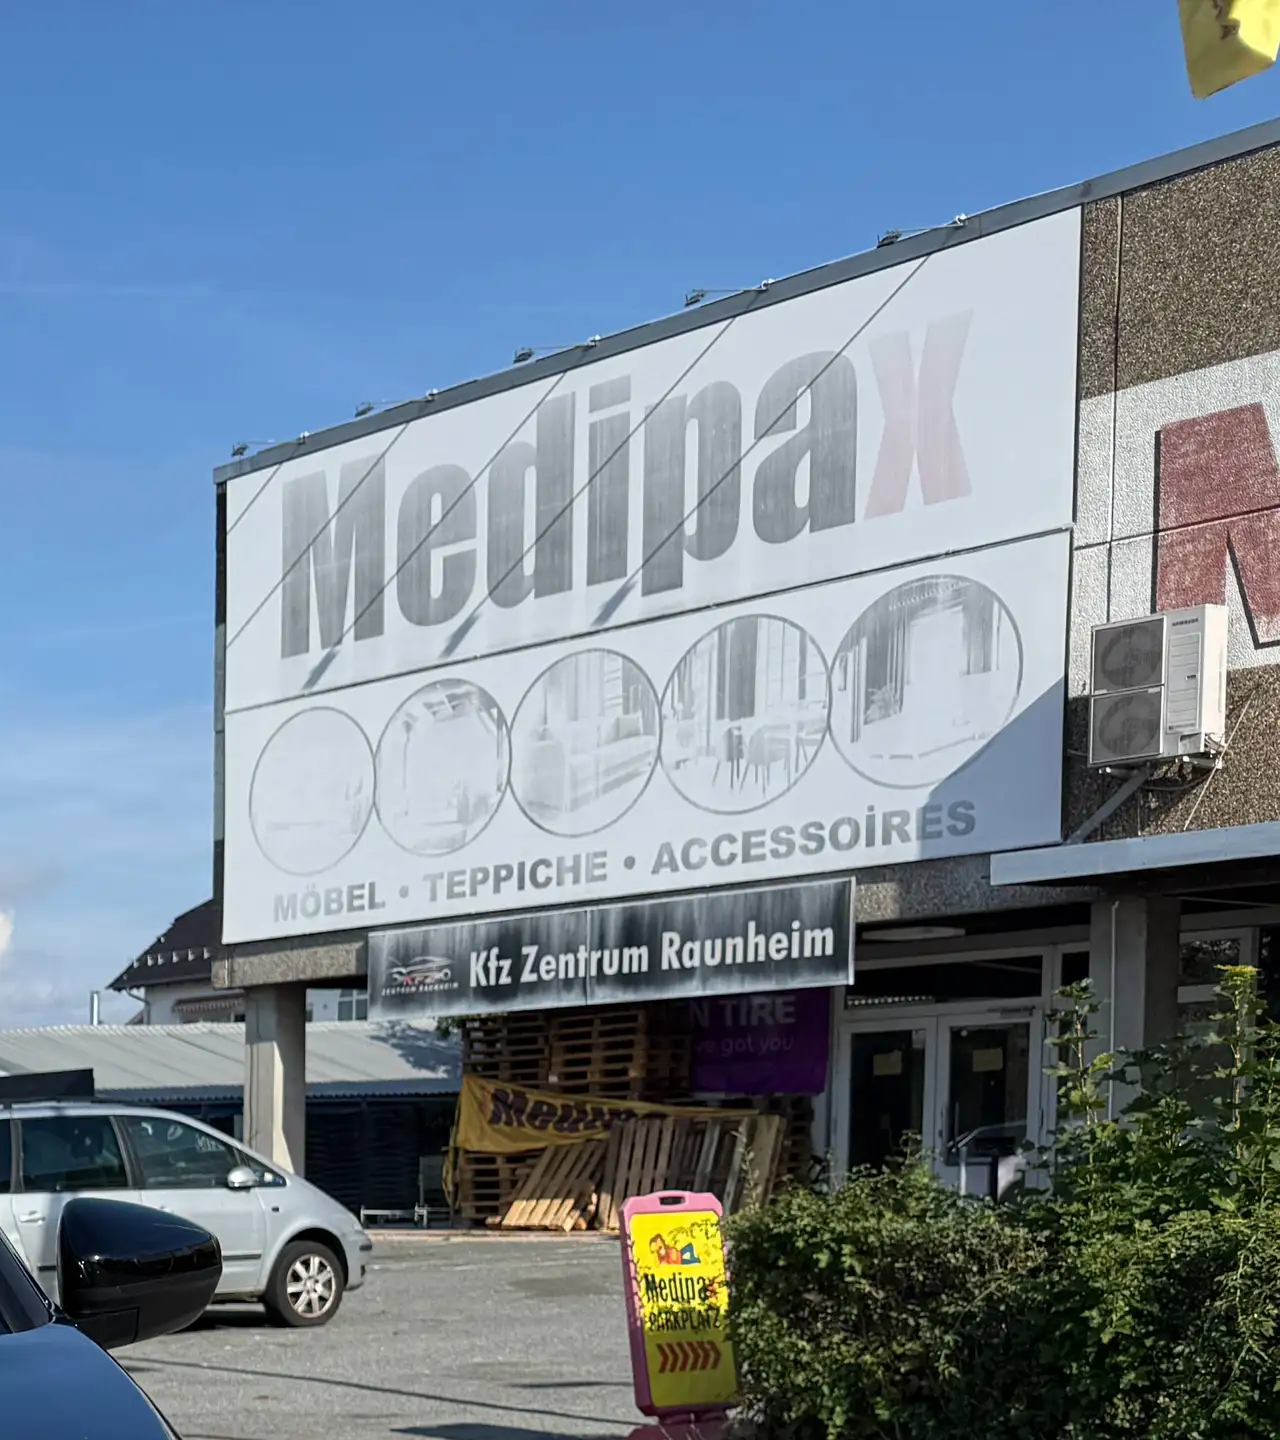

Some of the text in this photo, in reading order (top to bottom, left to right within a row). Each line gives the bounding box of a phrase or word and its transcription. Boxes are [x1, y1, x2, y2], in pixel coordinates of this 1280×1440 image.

[282, 309, 973, 659] Medipax
[272, 880, 385, 922] MÖBEL
[423, 849, 608, 903] TEPPICHE
[469, 921, 834, 987] Kfz Zentrum Raunheim
[718, 994, 797, 1027] TIRE
[721, 1033, 755, 1057] got
[759, 1035, 794, 1055] you
